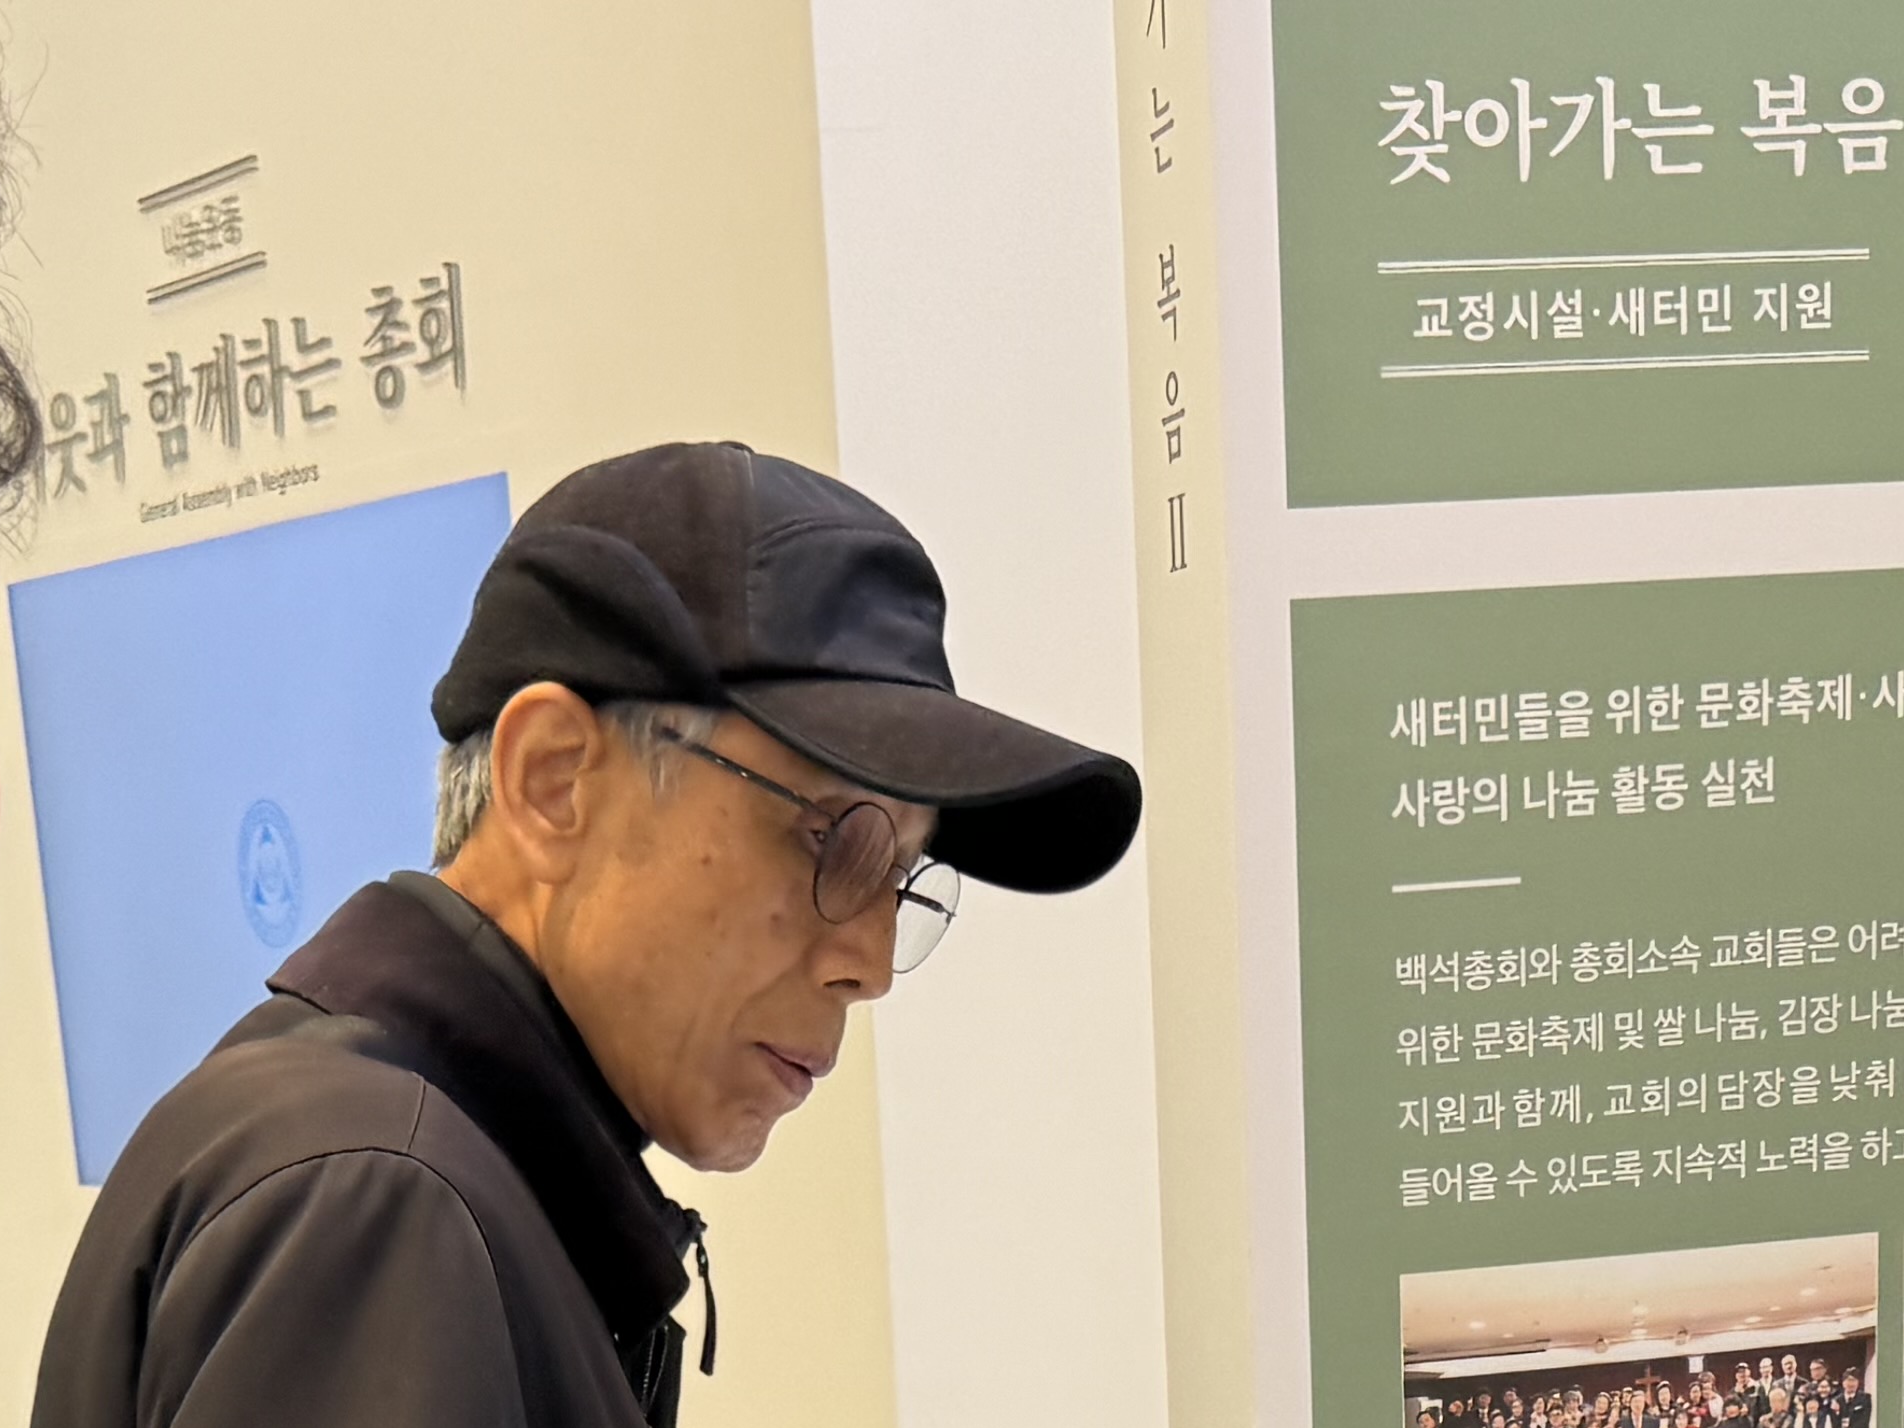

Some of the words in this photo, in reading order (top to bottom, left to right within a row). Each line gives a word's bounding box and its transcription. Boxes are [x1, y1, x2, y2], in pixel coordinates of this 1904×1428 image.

[1376, 75, 1715, 185] 찾아가는
[1739, 73, 1904, 177] 복음
[1752, 279, 1832, 332] 지원
[34, 371, 130, 506] 웃과
[142, 317, 342, 470] 함께하는
[359, 261, 467, 410] 총회
[1156, 244, 1186, 464] 복음
[1389, 689, 1593, 748] 새터민들을
[1604, 682, 1685, 735] 위한
[1390, 772, 1508, 828] 사랑의
[1522, 768, 1600, 819] 나눔
[1610, 762, 1689, 814] 활동
[1700, 755, 1775, 808] 실천
[1395, 942, 1563, 995] 백석총회와
[1568, 933, 1702, 983] 총회소속
[1708, 924, 1840, 969] 교회들은
[1395, 1021, 1464, 1066] 위한
[1471, 1010, 1604, 1060] 문화축제
[1613, 1007, 1644, 1051] 및
[1652, 1004, 1687, 1047] 쌀
[1694, 1000, 1767, 1043] 나눔,
[1777, 992, 1843, 1037] 김장
[1397, 1089, 1506, 1136] 지원과
[1602, 1072, 1707, 1117] 교회의
[1717, 1065, 1822, 1111] 담장을
[1829, 1056, 1895, 1102] 낮춰
[1398, 1161, 1498, 1207] 들어올
[1505, 1158, 1538, 1198] 수
[1546, 1148, 1644, 1195] 있도록
[1651, 1138, 1746, 1184] 지속적
[1755, 1130, 1853, 1173] 노력을
